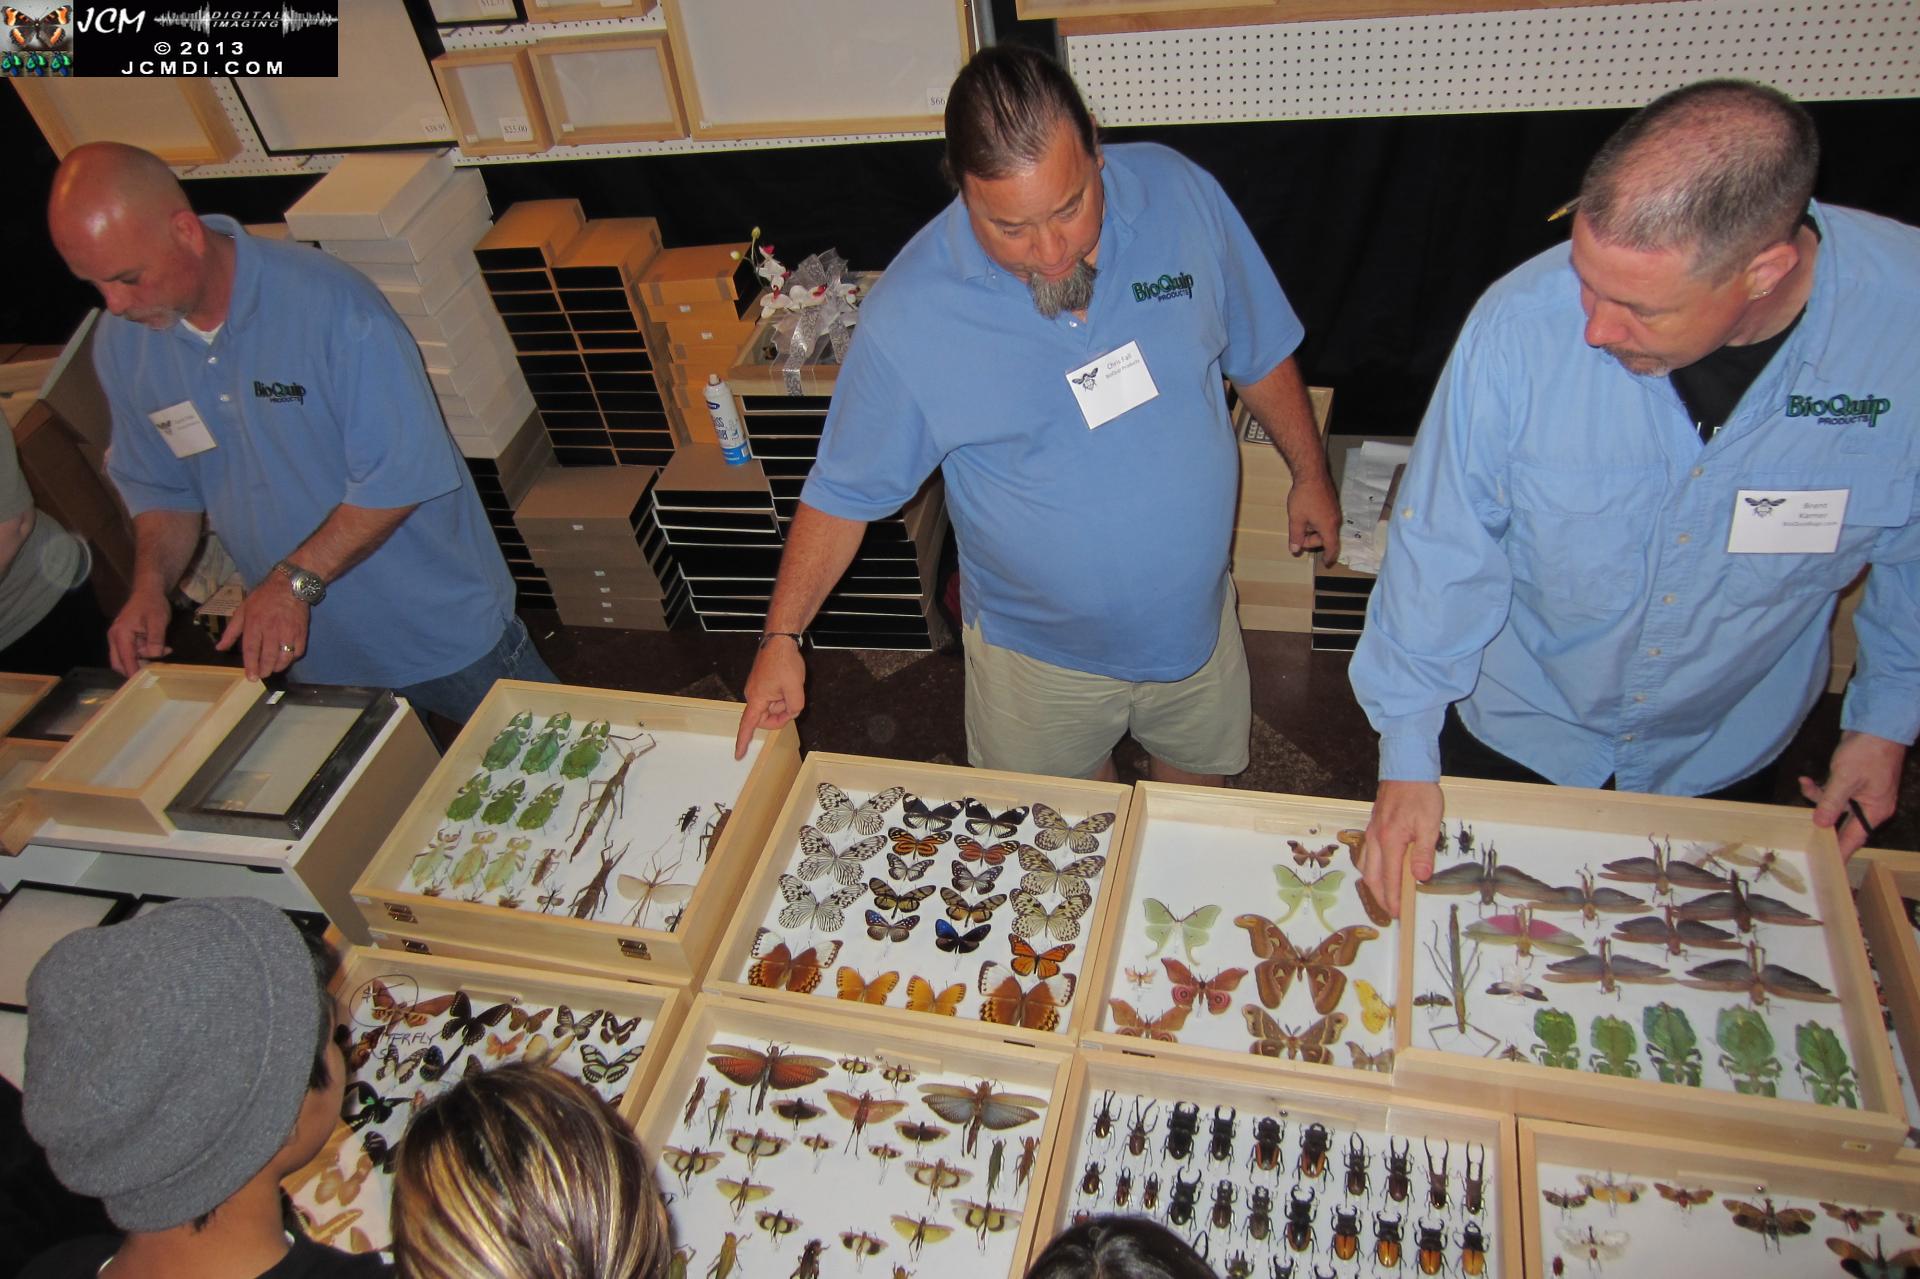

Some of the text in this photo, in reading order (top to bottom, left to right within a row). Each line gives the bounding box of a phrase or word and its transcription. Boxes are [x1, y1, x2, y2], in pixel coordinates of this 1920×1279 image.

[1132, 271, 1194, 303] BioQuip
[253, 380, 306, 405] BioQuip
[1785, 393, 1891, 428] BioQuip
[1817, 414, 1870, 426] PRODUCTS
